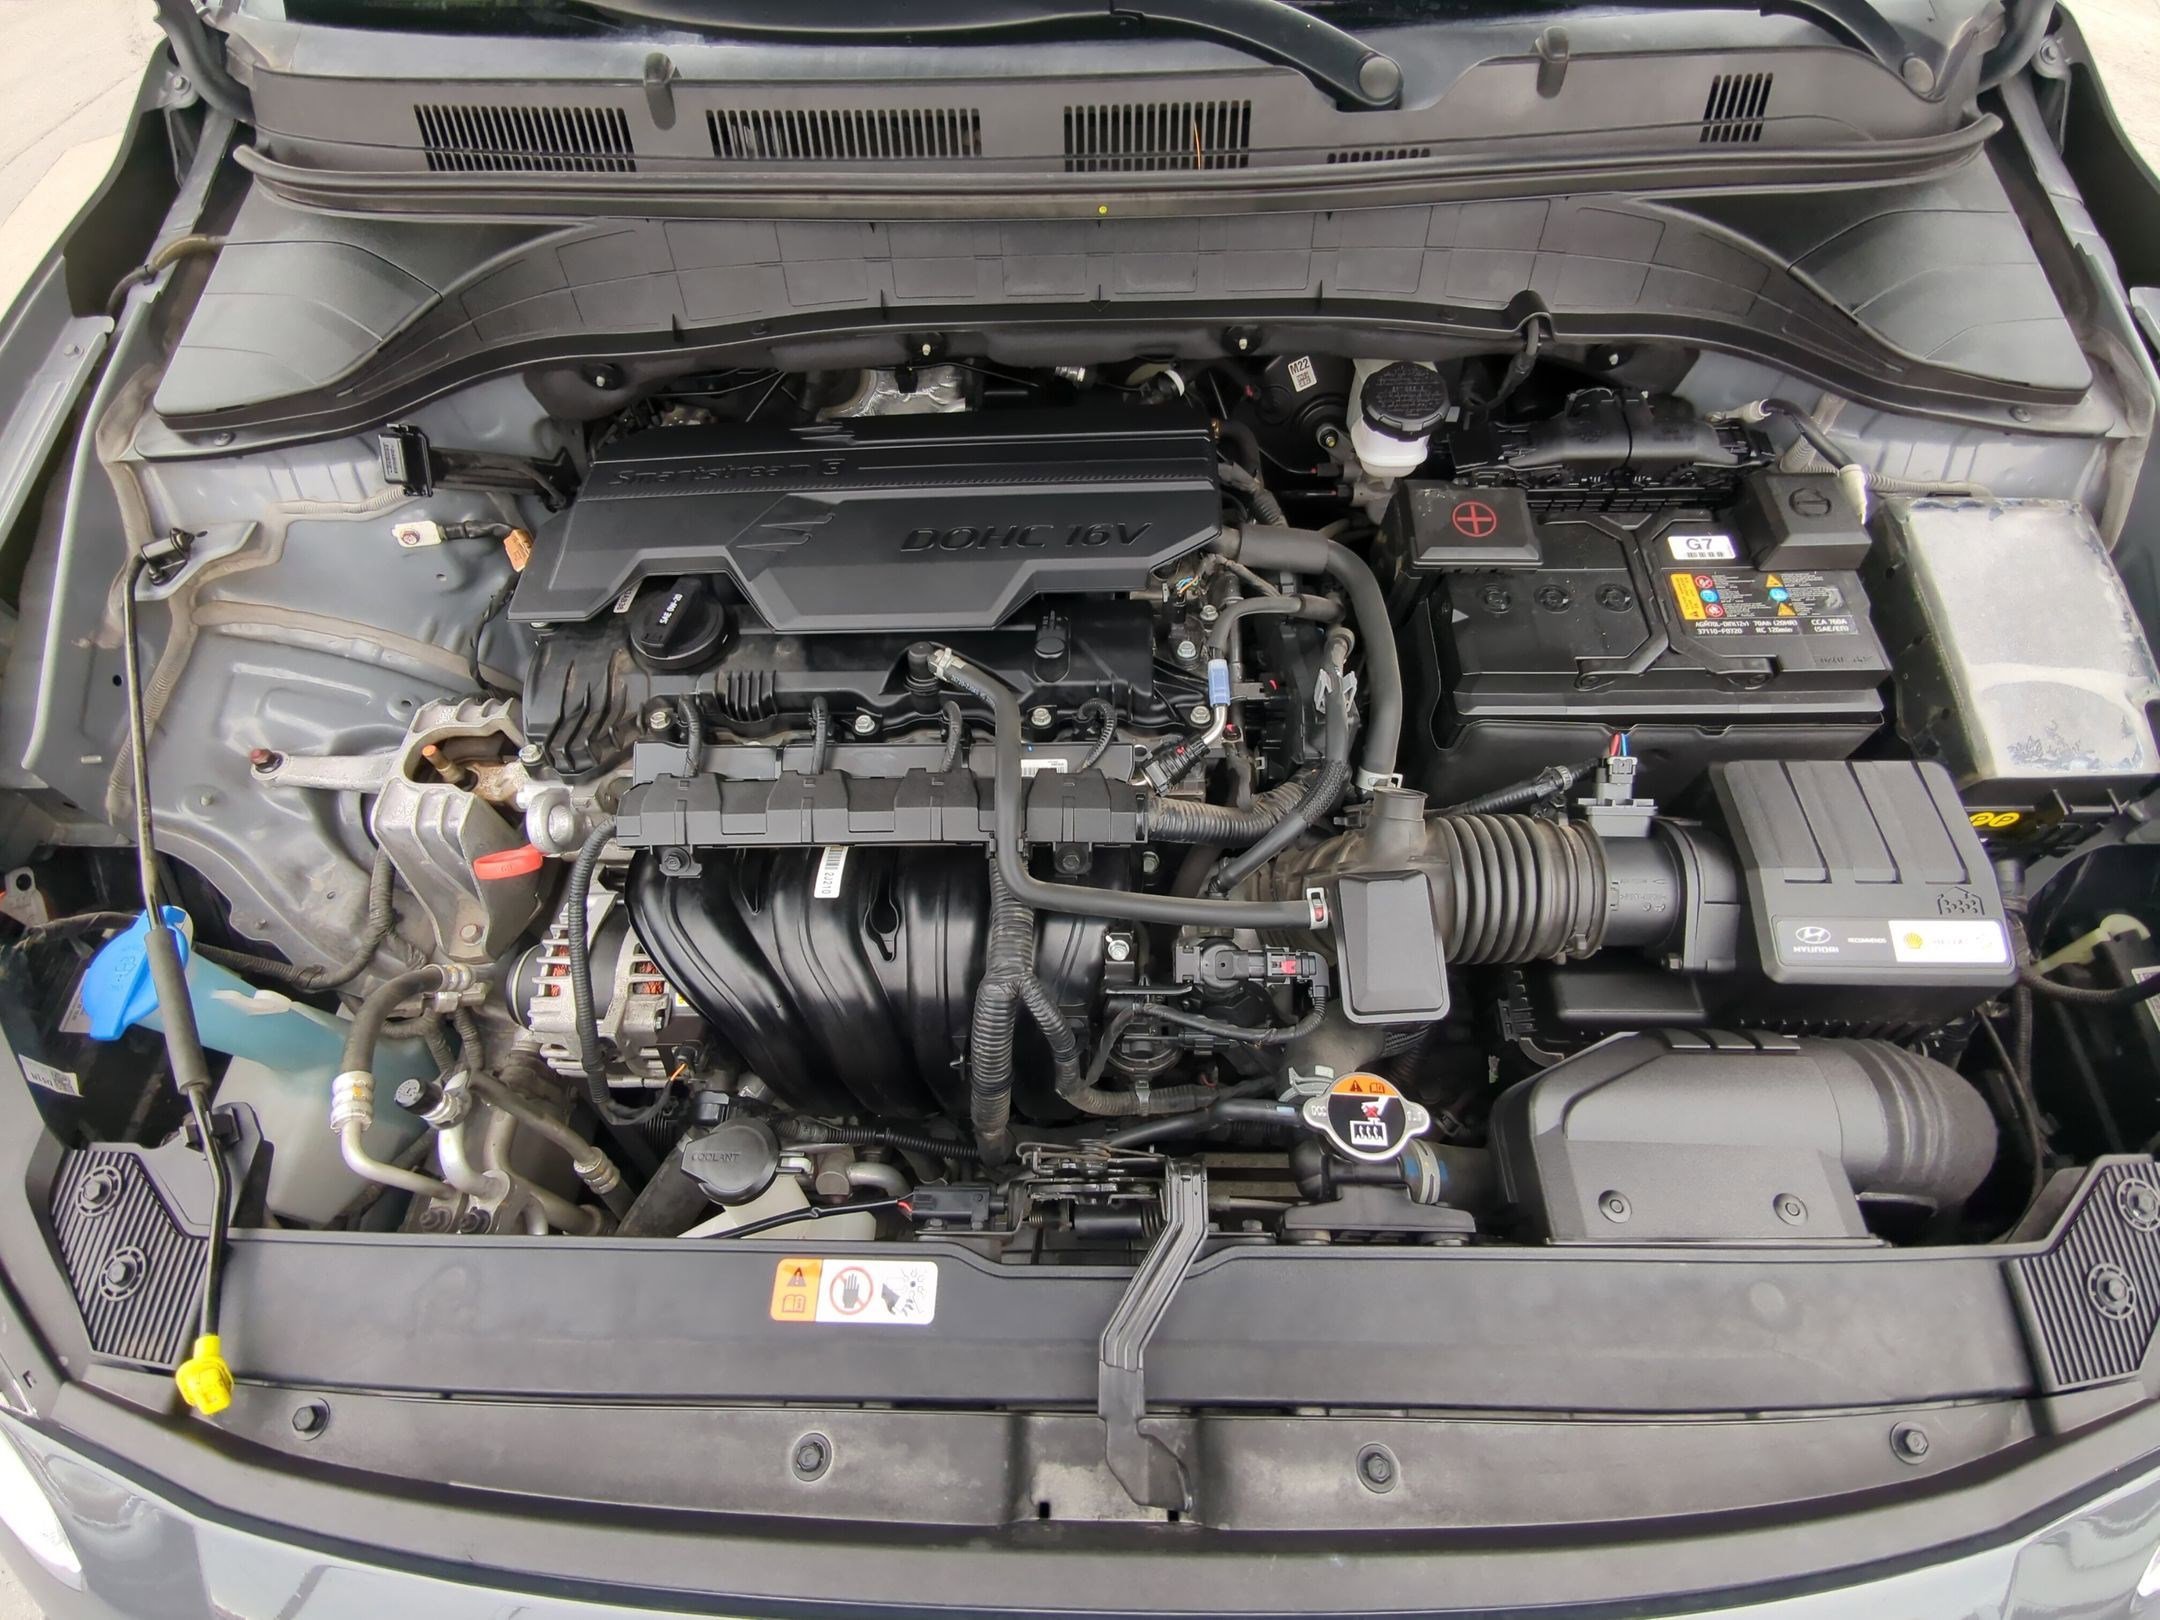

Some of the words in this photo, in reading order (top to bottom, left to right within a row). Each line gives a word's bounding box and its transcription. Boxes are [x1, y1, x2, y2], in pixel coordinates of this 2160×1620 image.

[1289, 358, 1310, 376] M22
[900, 524, 1054, 551] DOHC
[1064, 522, 1153, 548] 16V
[1685, 537, 1713, 551] G7
[1793, 945, 1839, 953] HYUNDAI
[691, 1153, 740, 1161] COOLANT
